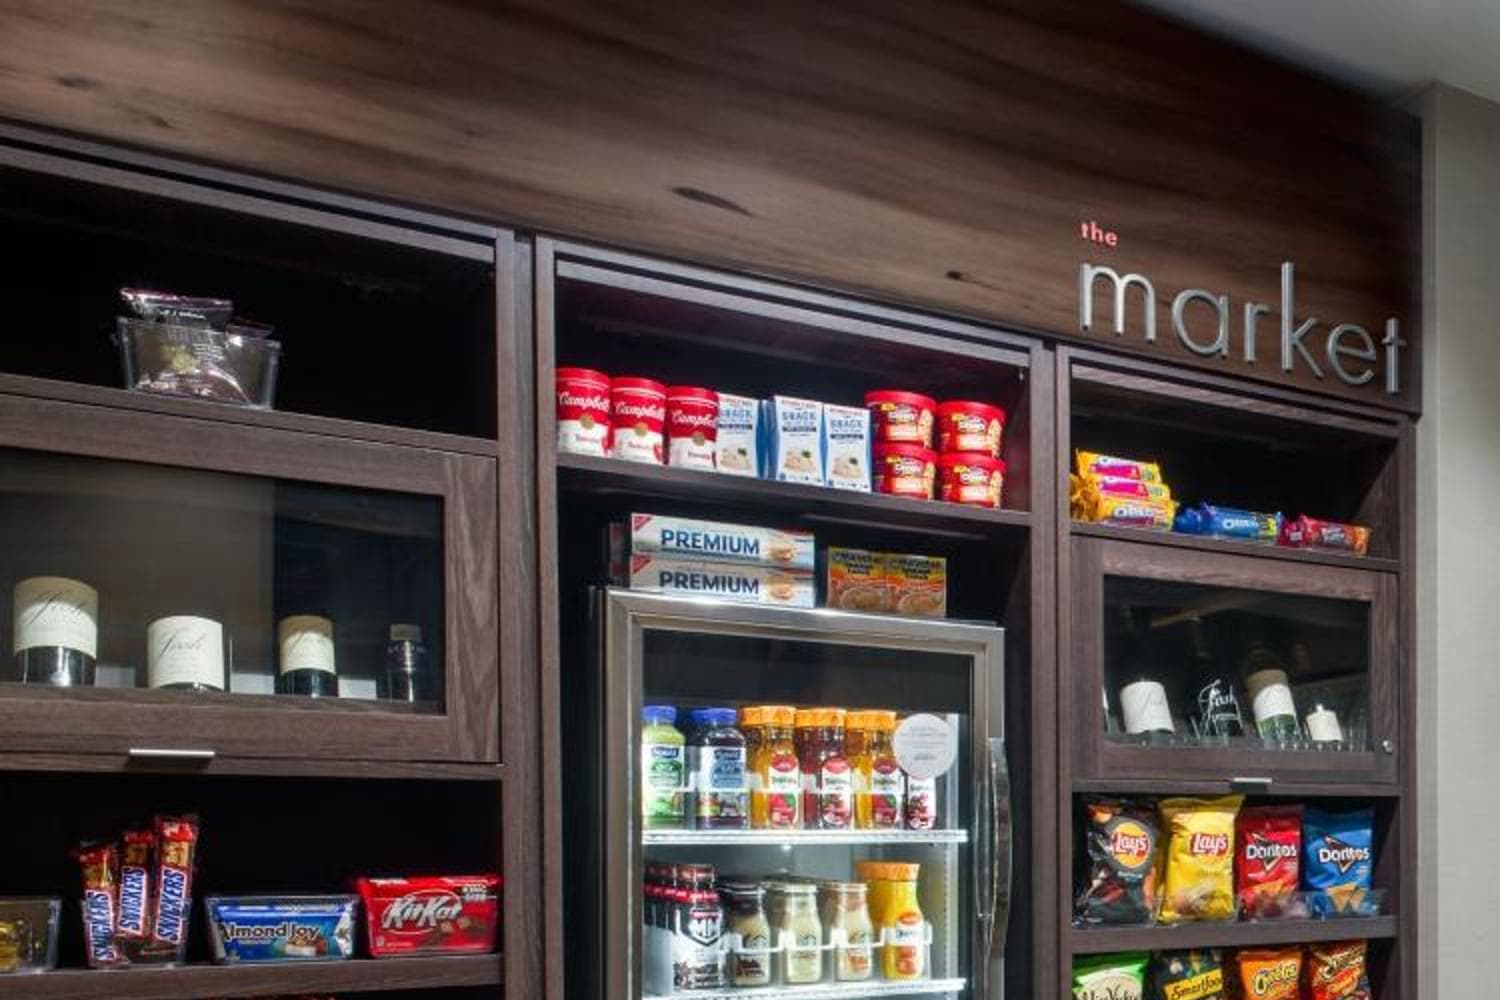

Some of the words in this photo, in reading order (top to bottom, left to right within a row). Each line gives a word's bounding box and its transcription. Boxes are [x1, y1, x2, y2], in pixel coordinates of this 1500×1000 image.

[1081, 222, 1119, 247] the
[1079, 260, 1408, 397] market
[660, 528, 761, 555] PREMIUM
[659, 571, 760, 595] PREMIUM
[1245, 844, 1298, 859] Doritos
[1318, 846, 1371, 863] Doritos
[1170, 972, 1223, 1000] Smartfoo
